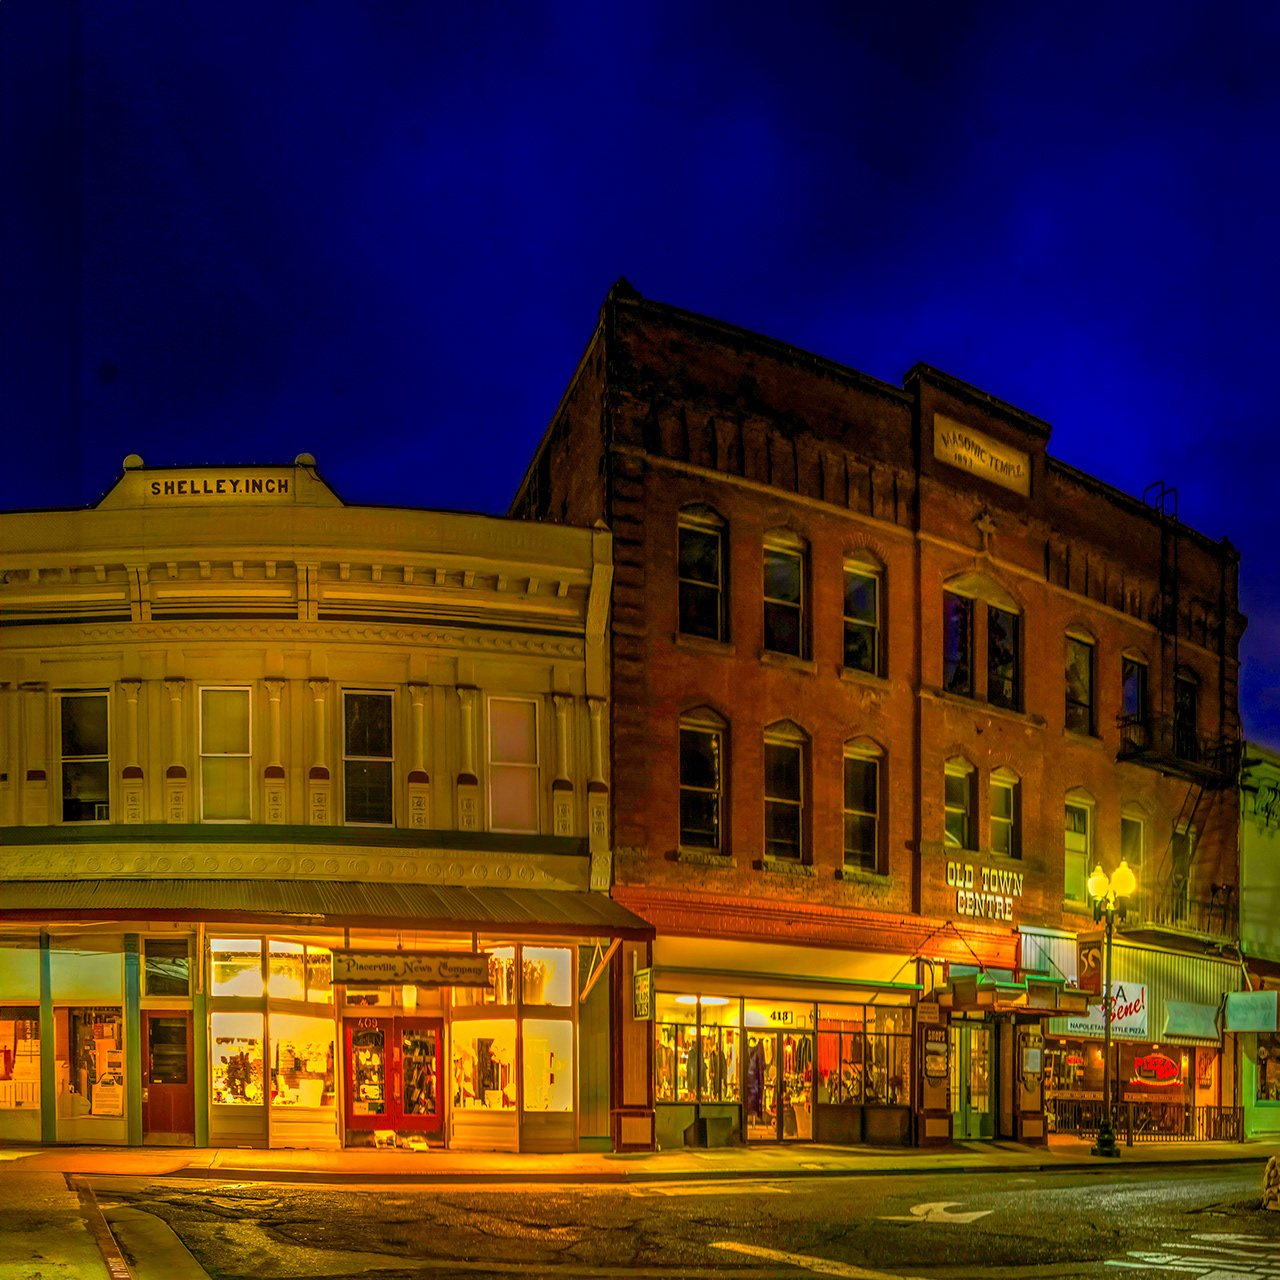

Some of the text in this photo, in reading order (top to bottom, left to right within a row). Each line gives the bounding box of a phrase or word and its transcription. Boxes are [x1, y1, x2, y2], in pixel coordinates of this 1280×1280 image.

[941, 431, 1024, 478] MASONIC TEMPLE
[946, 861, 1023, 897] OLD TOWN
[956, 889, 1013, 921] CENTRE
[337, 959, 483, 979] Placerville News Company
[358, 1018, 378, 1028] 409
[1134, 1057, 1172, 1071] PIZZA
